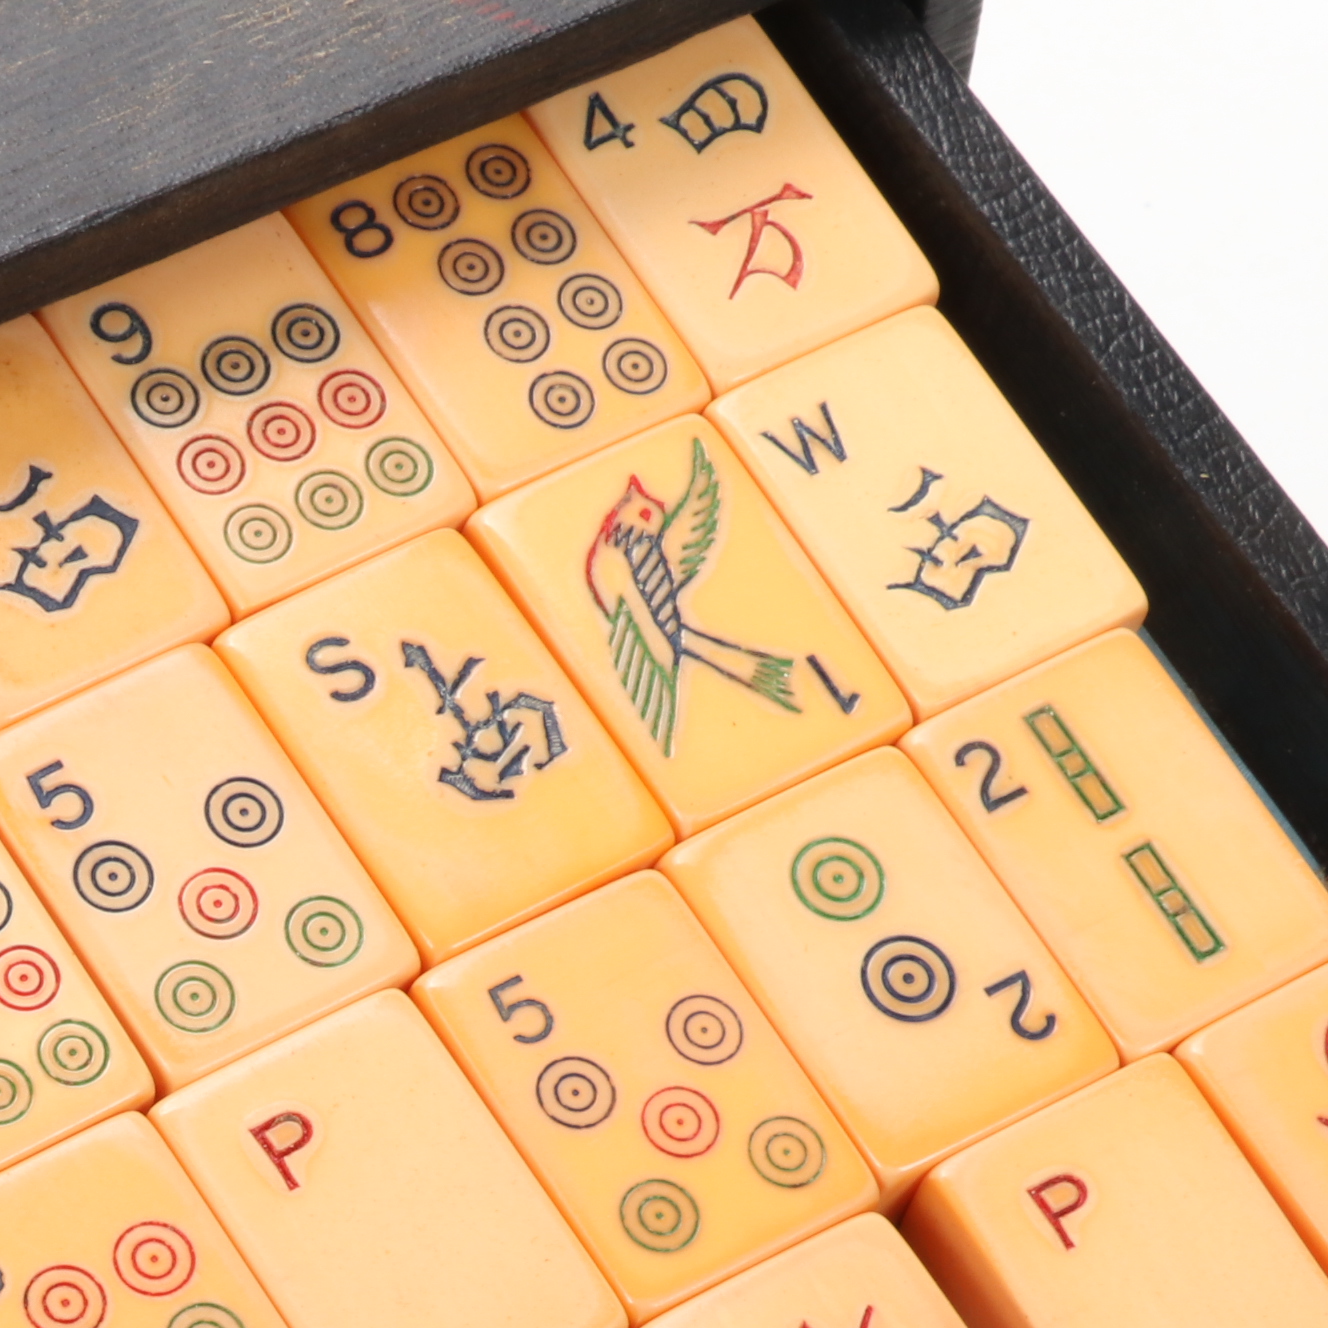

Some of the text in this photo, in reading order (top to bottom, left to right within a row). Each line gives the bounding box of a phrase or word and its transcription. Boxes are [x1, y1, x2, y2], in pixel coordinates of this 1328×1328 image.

[583, 91, 635, 151] 4
[330, 200, 394, 258] 8
[89, 302, 153, 365] 9
[760, 401, 848, 476] W
[304, 636, 376, 703] S
[805, 654, 861, 715] 1
[25, 759, 94, 831] 5
[954, 740, 1029, 814] 2
[487, 974, 554, 1045] 5
[983, 969, 1057, 1042] 2
[248, 1111, 314, 1192] P
[1026, 1173, 1089, 1251] P
